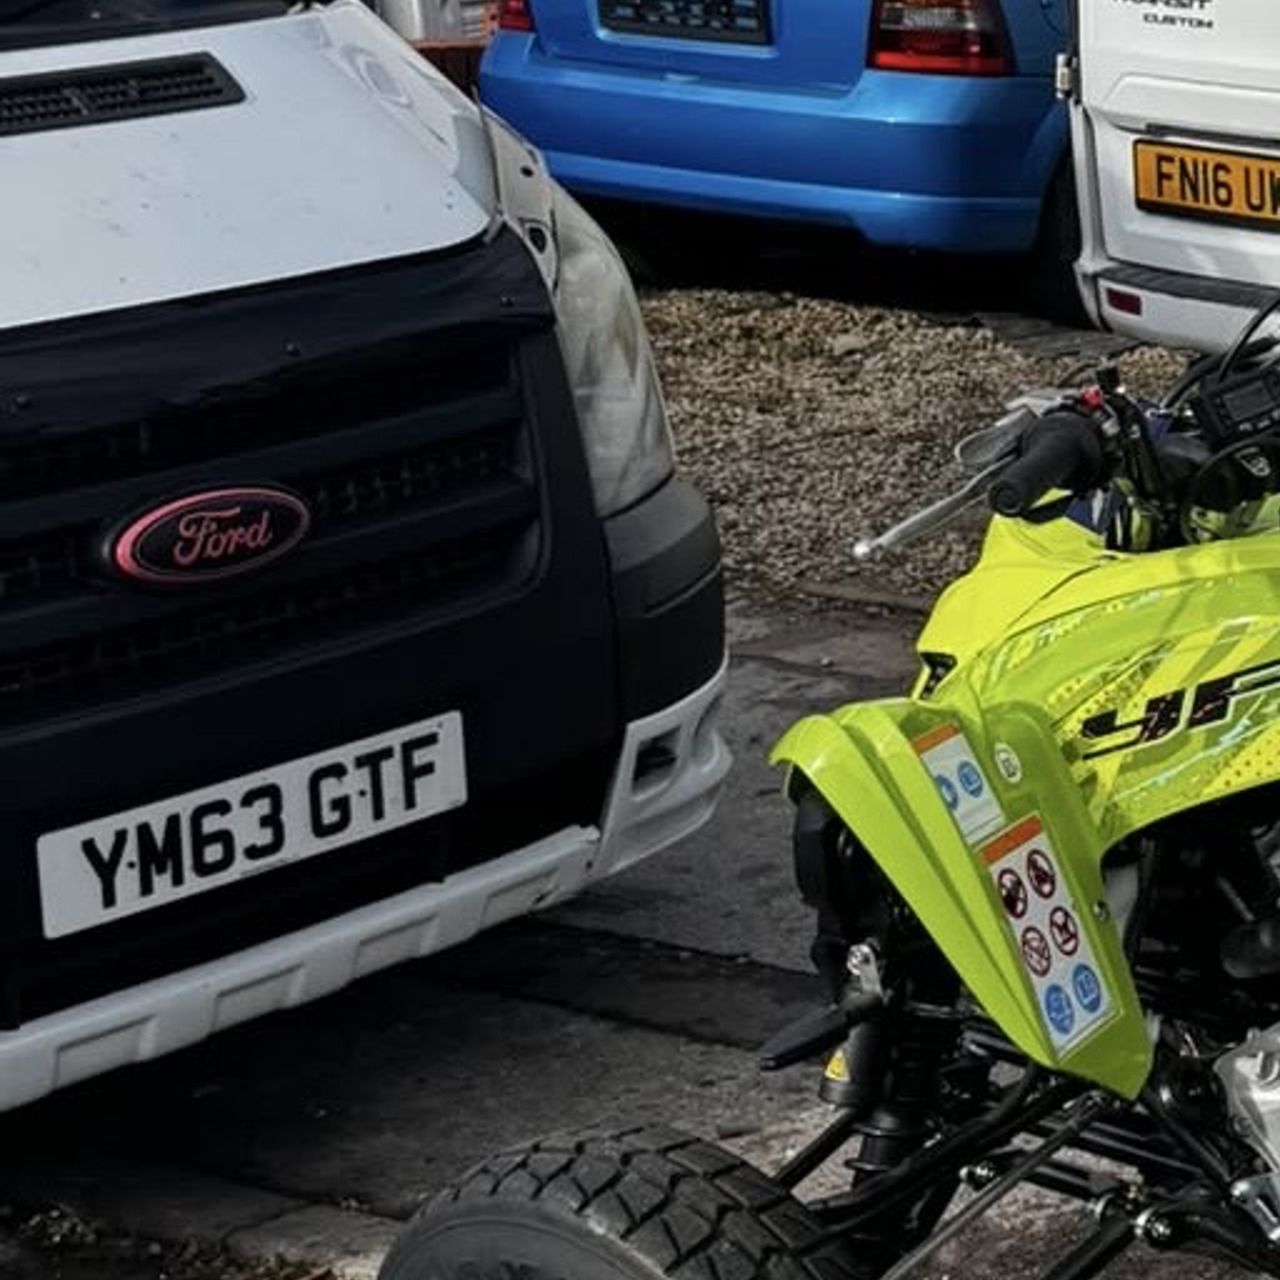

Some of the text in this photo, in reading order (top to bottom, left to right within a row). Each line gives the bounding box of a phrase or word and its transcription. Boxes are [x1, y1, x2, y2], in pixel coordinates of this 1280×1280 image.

[1142, 12, 1214, 29] CUSTOM
[1155, 153, 1233, 208] FN16
[171, 507, 273, 566] Ford
[81, 731, 440, 909] YM63 GTF
